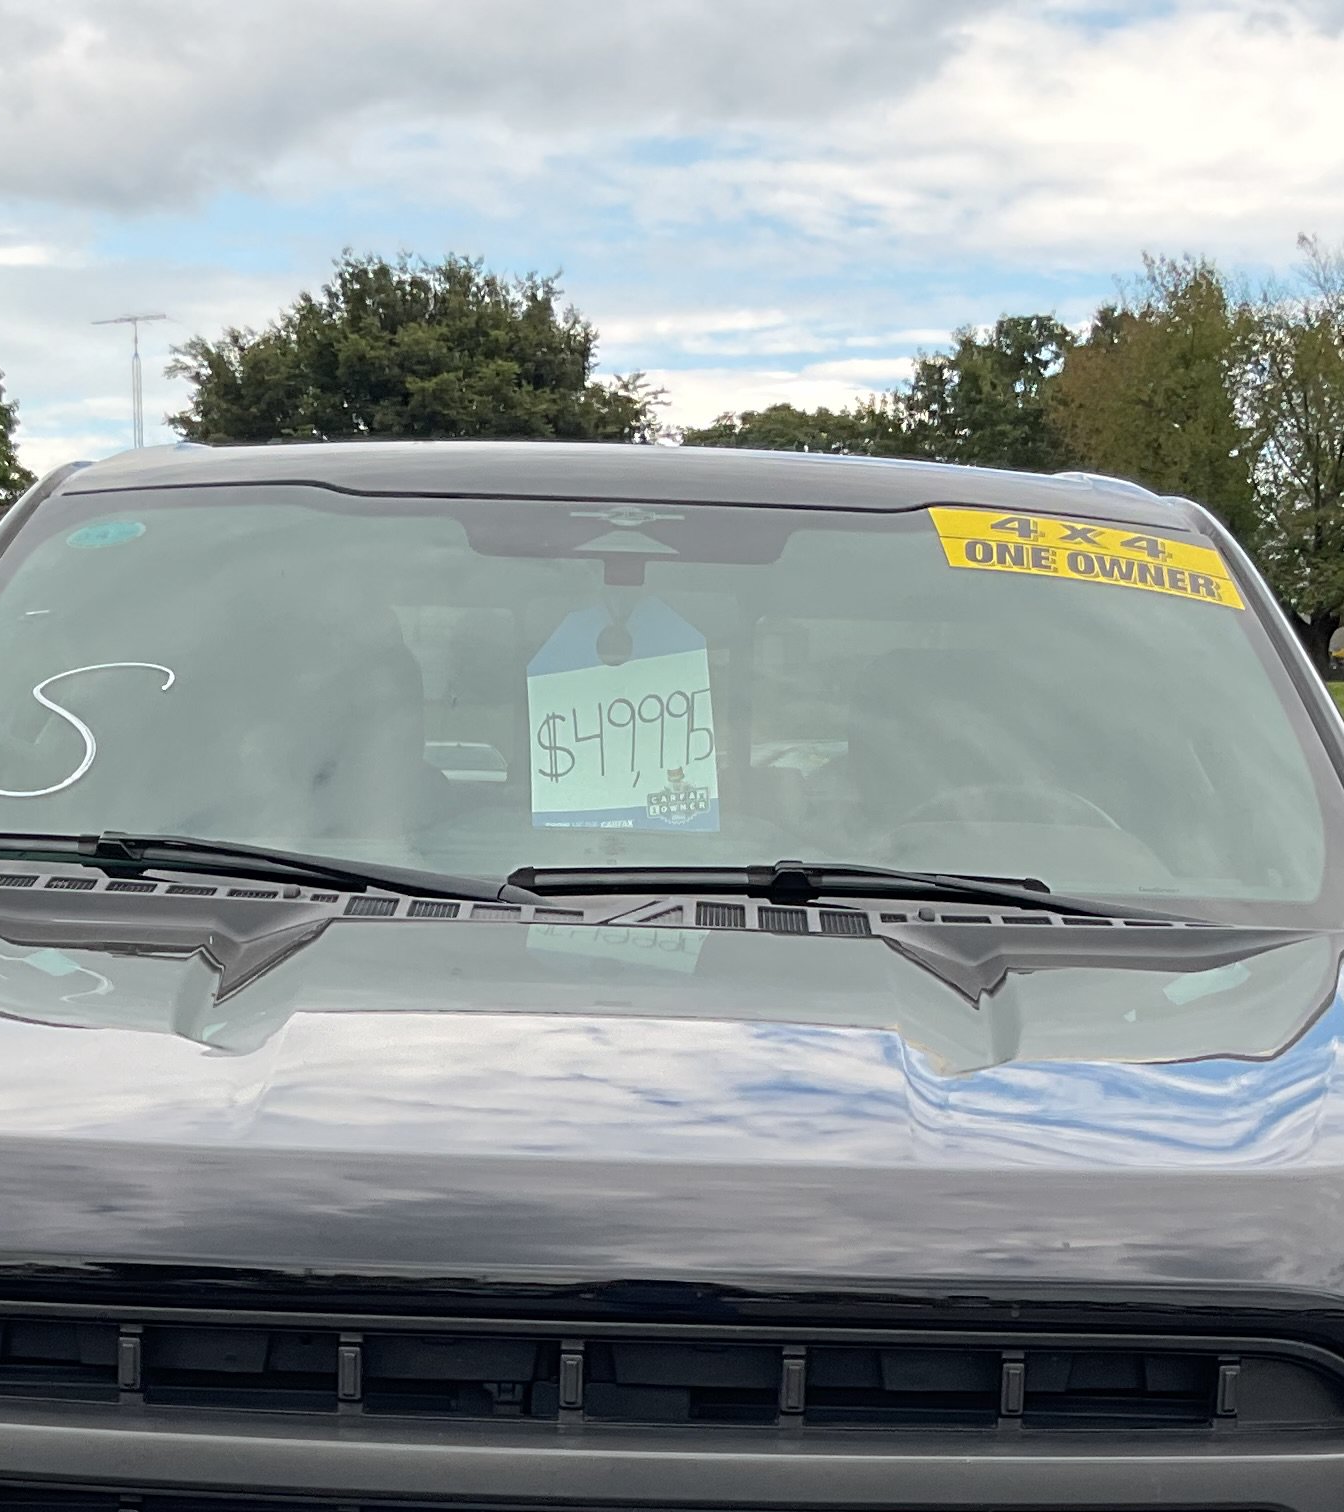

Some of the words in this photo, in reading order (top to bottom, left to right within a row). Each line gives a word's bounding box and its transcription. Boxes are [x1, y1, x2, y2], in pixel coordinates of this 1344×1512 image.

[964, 540, 1058, 573] ONE
[1066, 551, 1223, 602] OWNER
[537, 688, 715, 789] $49,995
[651, 789, 707, 803] CARFAX
